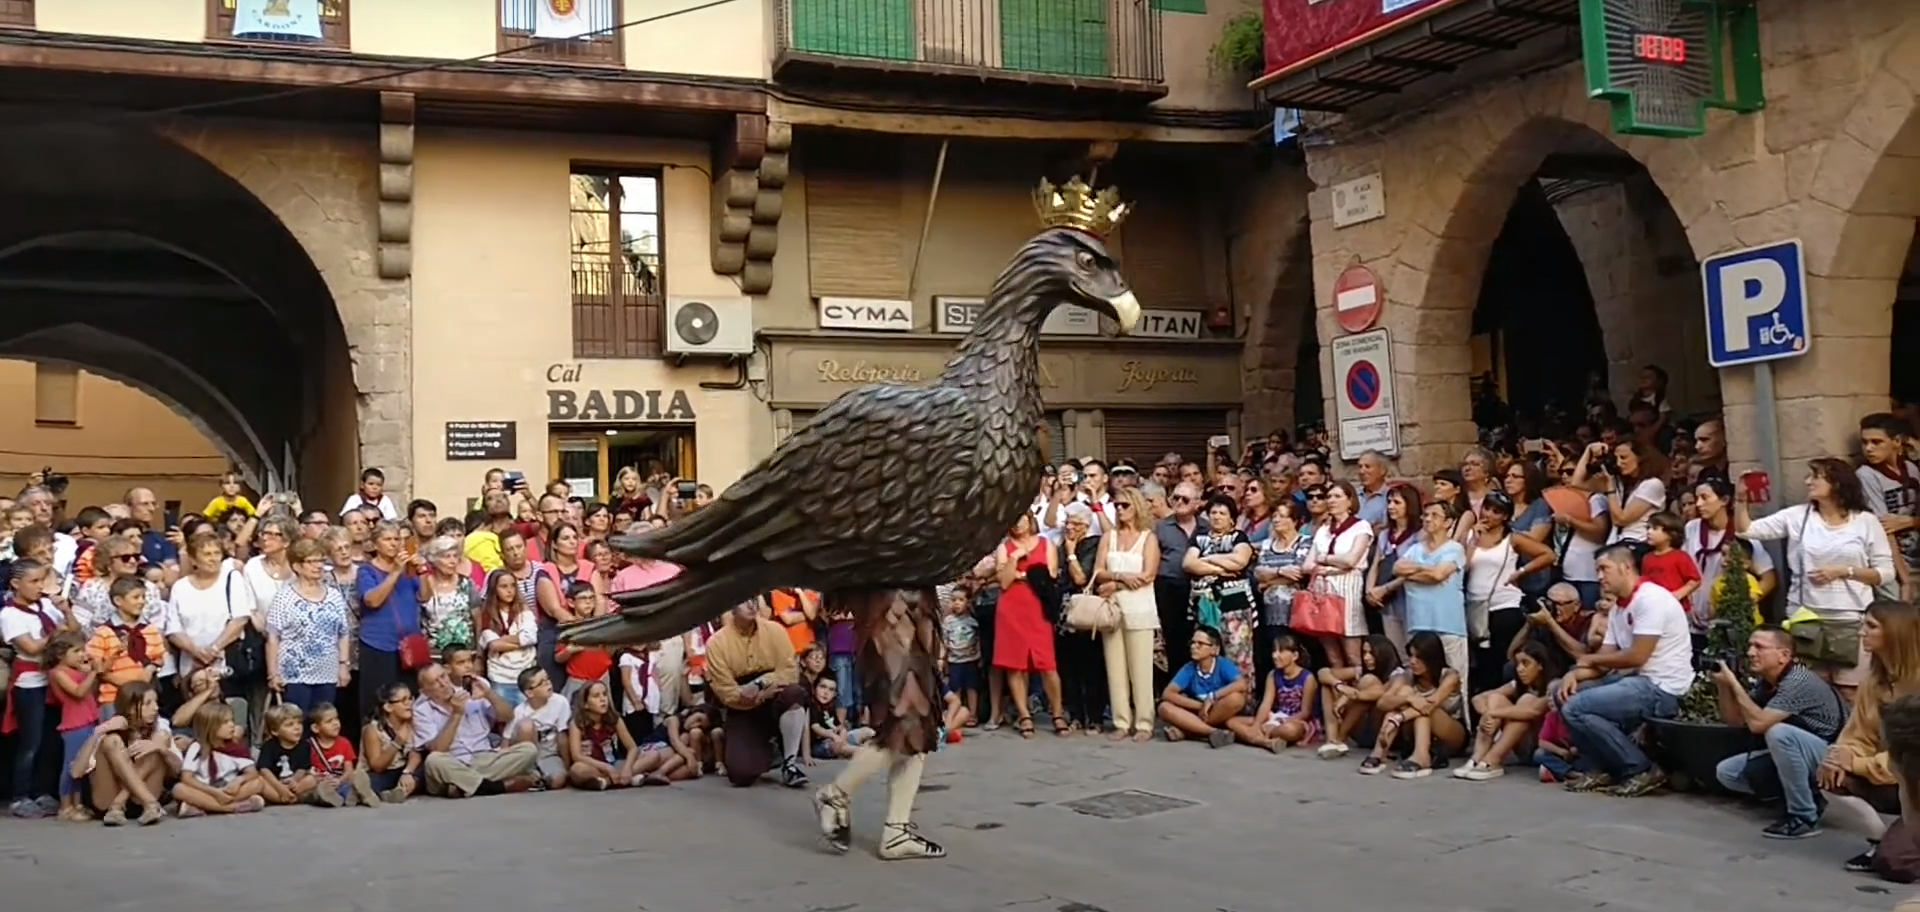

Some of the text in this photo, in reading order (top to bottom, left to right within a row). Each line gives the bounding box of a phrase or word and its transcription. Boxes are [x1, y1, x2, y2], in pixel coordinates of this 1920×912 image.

[824, 305, 909, 323] CYMA
[1719, 258, 1787, 352] P
[1142, 315, 1197, 334] ITAN
[546, 363, 582, 383] Cal
[546, 389, 697, 420] BADIA
